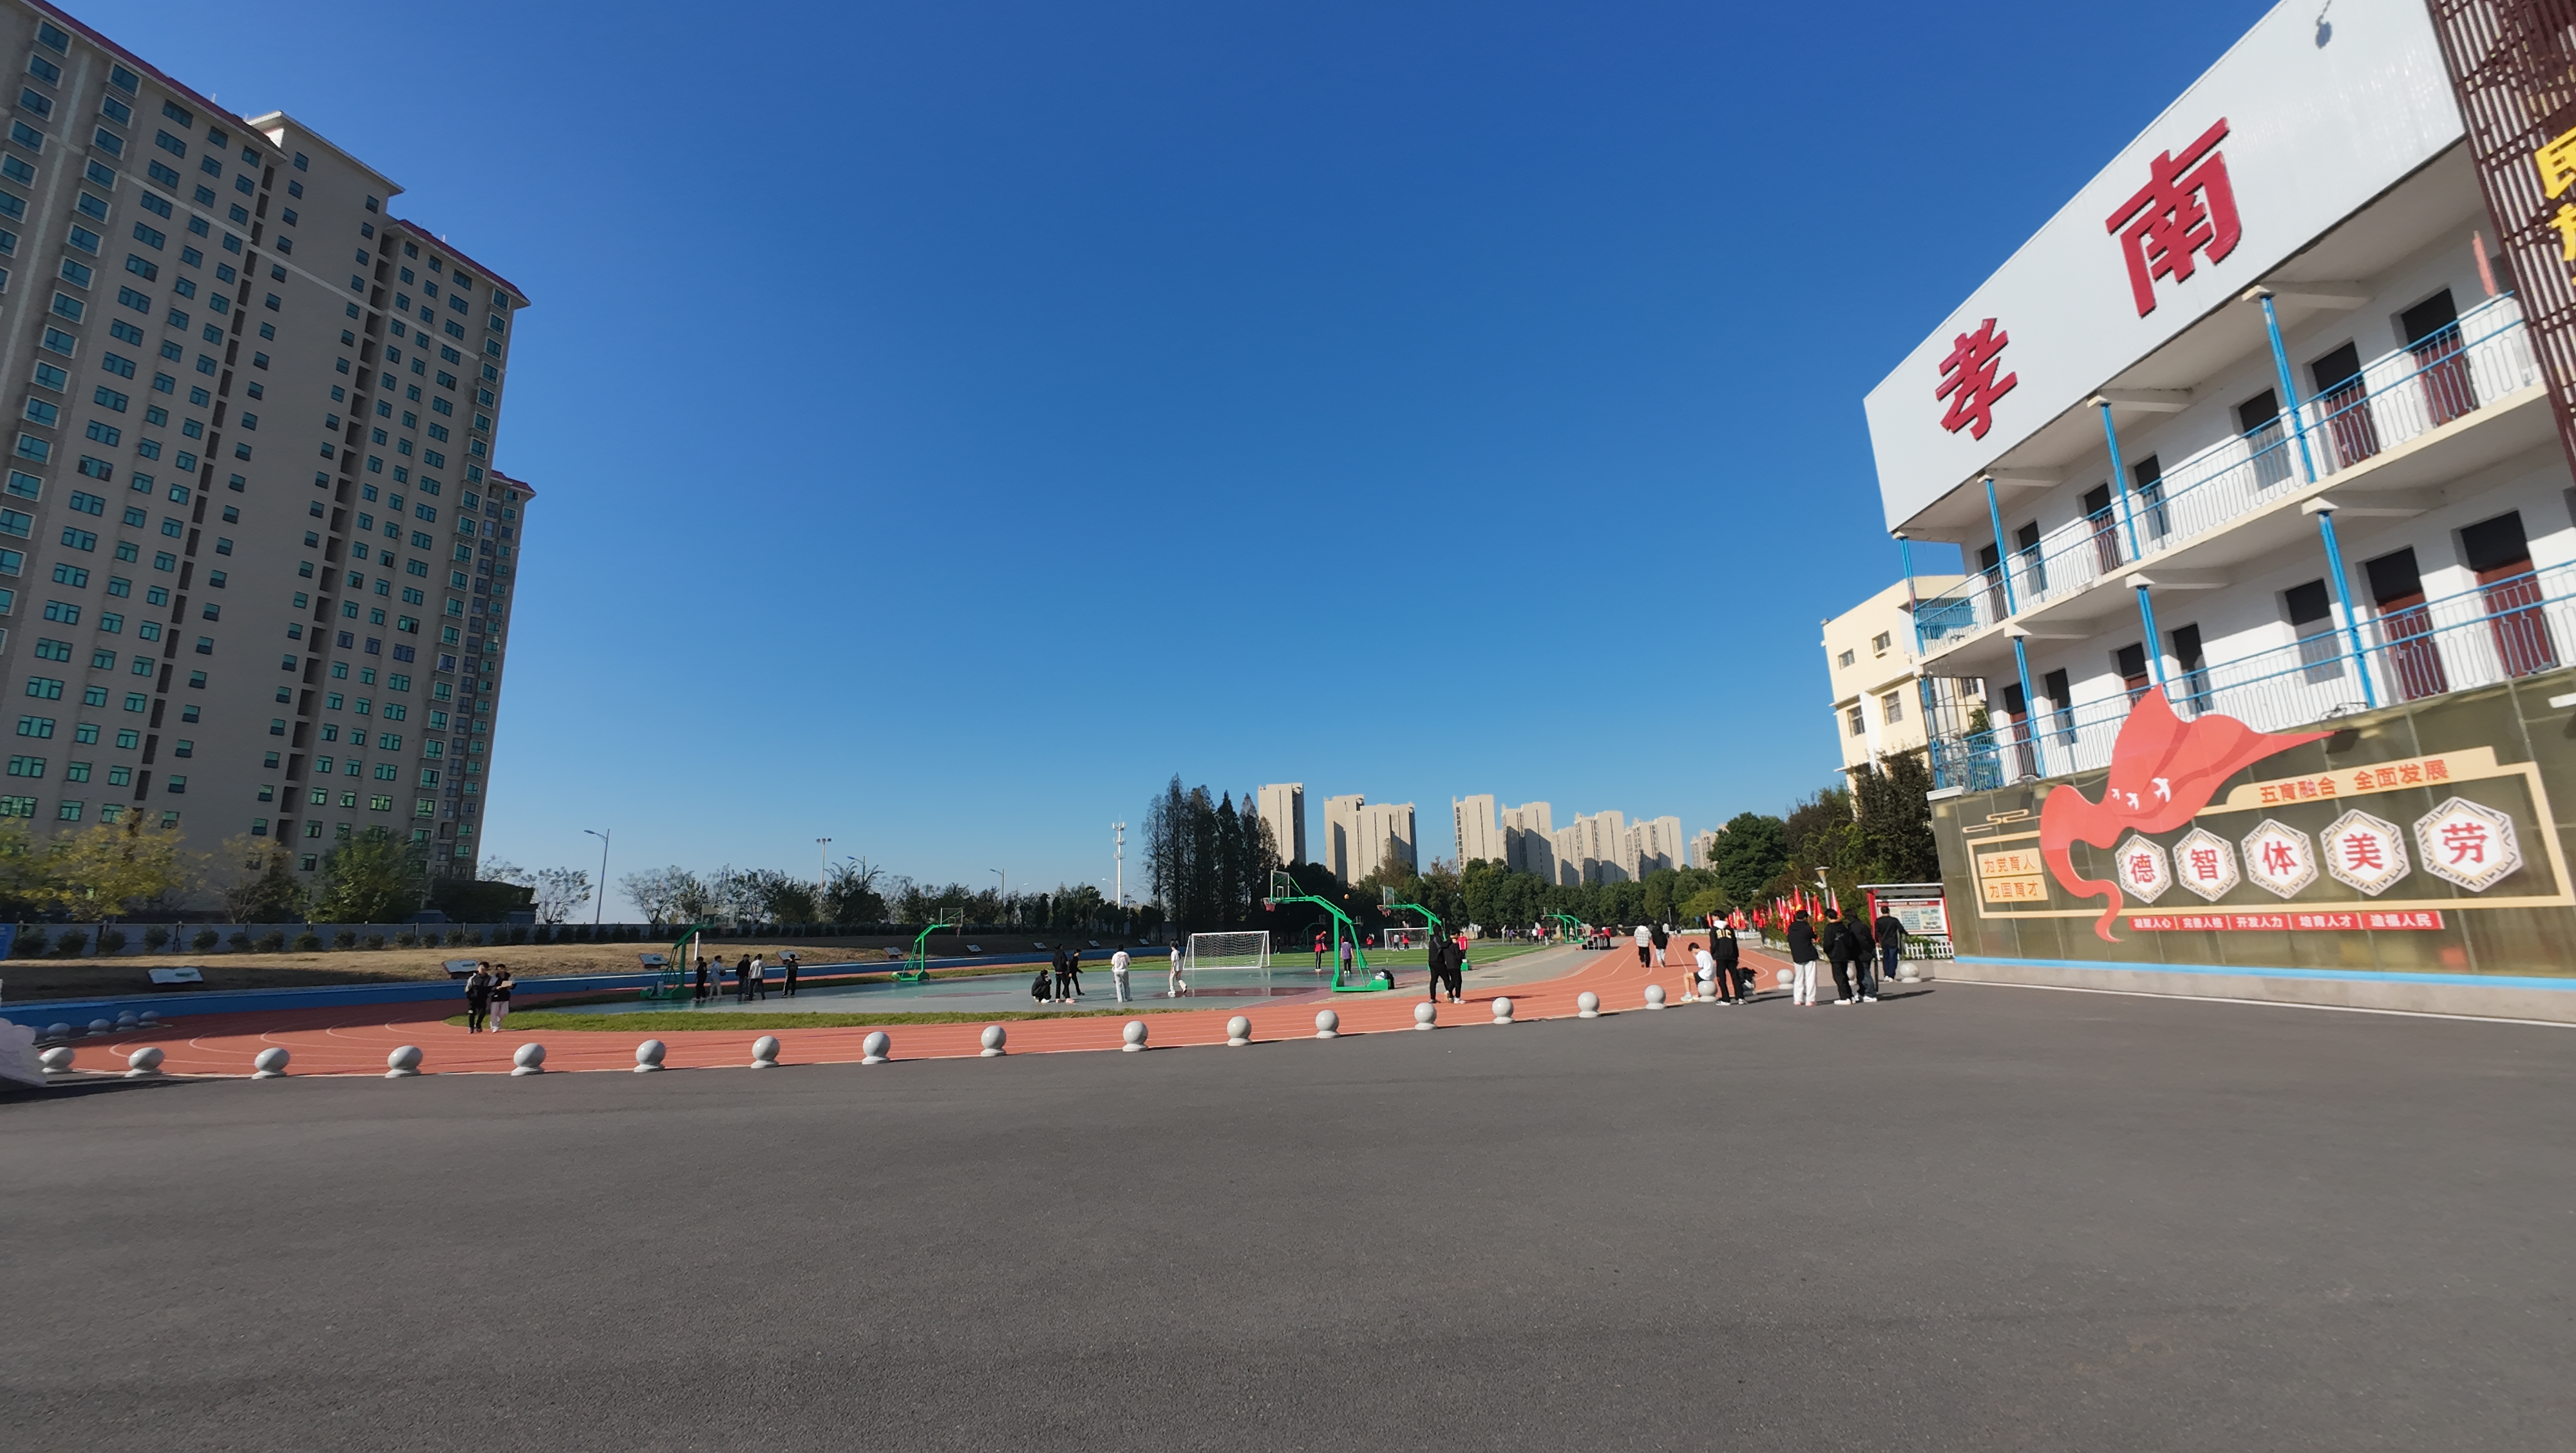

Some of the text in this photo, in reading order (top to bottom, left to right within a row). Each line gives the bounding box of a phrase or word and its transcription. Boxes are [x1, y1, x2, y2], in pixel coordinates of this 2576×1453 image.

[2259, 759, 2449, 803] 五育融合 全面发展
[1984, 854, 2036, 873] 为党育人
[1989, 880, 2039, 898] 为国育才
[2236, 916, 2284, 928] 开发人力
[2299, 914, 2352, 927] 培育人才
[2369, 913, 2433, 927] 造福人民
